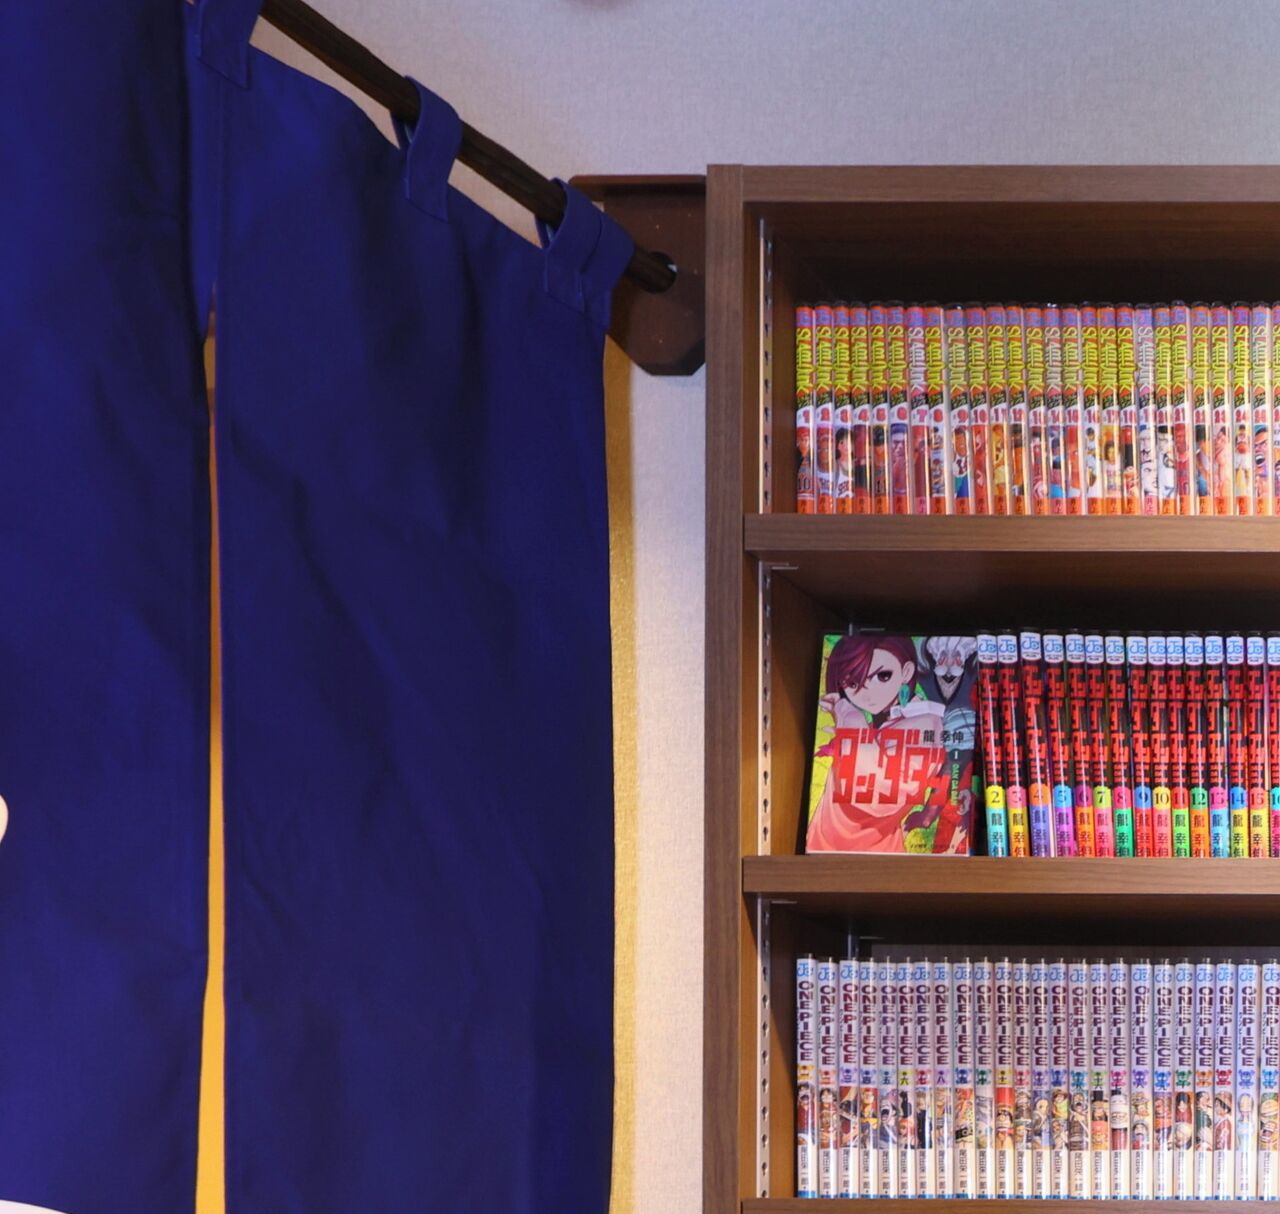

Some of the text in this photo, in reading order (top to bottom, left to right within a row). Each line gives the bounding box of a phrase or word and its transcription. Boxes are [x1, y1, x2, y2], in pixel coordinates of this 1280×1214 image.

[992, 791, 1000, 803] 2
[1013, 790, 1021, 803] 3
[1154, 791, 1170, 806] 10
[1191, 790, 1208, 806] 12
[799, 981, 813, 1061] ONE PIECE
[820, 986, 835, 1065] ONE PIECE
[862, 986, 876, 1065] ONE PIECE
